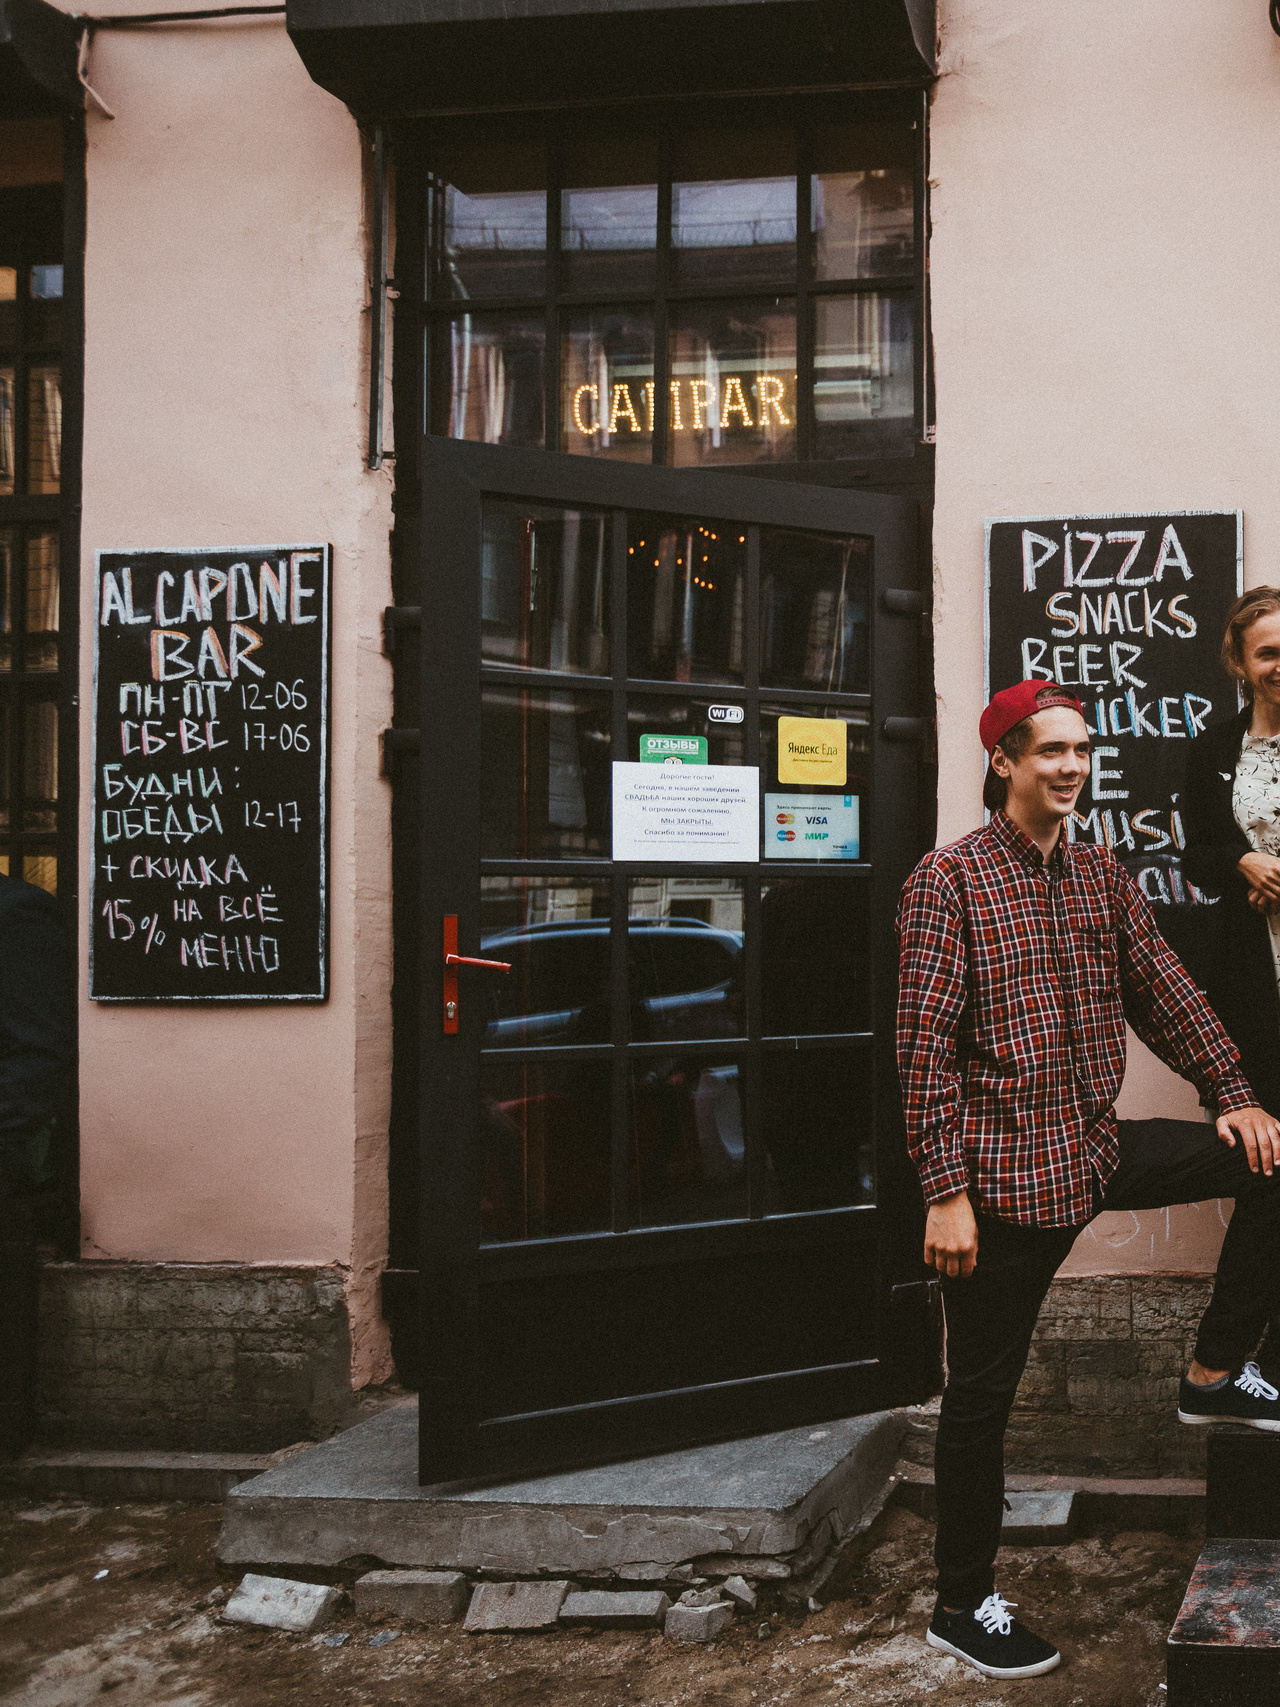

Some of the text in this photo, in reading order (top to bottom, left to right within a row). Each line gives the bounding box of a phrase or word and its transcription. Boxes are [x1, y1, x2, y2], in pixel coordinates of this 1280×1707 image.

[1022, 523, 1194, 592] PiZZA
[101, 552, 323, 627] AL CAPONE
[1045, 591, 1198, 639] SNACKS
[150, 623, 265, 681] BAR
[1021, 637, 1148, 689] BEER
[119, 679, 308, 719] ПН-ПТ 12-06
[121, 720, 311, 755] СБ-ВС 17-06
[647, 739, 699, 751] ОТЗЫВЫ
[787, 741, 838, 756] Яндекс Еда
[633, 783, 666, 791] Сегодня,
[659, 772, 692, 780] Дорогие
[624, 793, 660, 801] СВАДЬБА
[102, 801, 302, 844] ОБЕДЫ 12-17
[644, 828, 675, 836] Спасибо
[804, 832, 830, 841] МИР
[805, 816, 828, 825] VISA
[129, 854, 249, 891] СКИДКА
[173, 898, 202, 922] НА
[219, 886, 284, 923] ВСЁ
[181, 935, 280, 973] МЕНЮ
